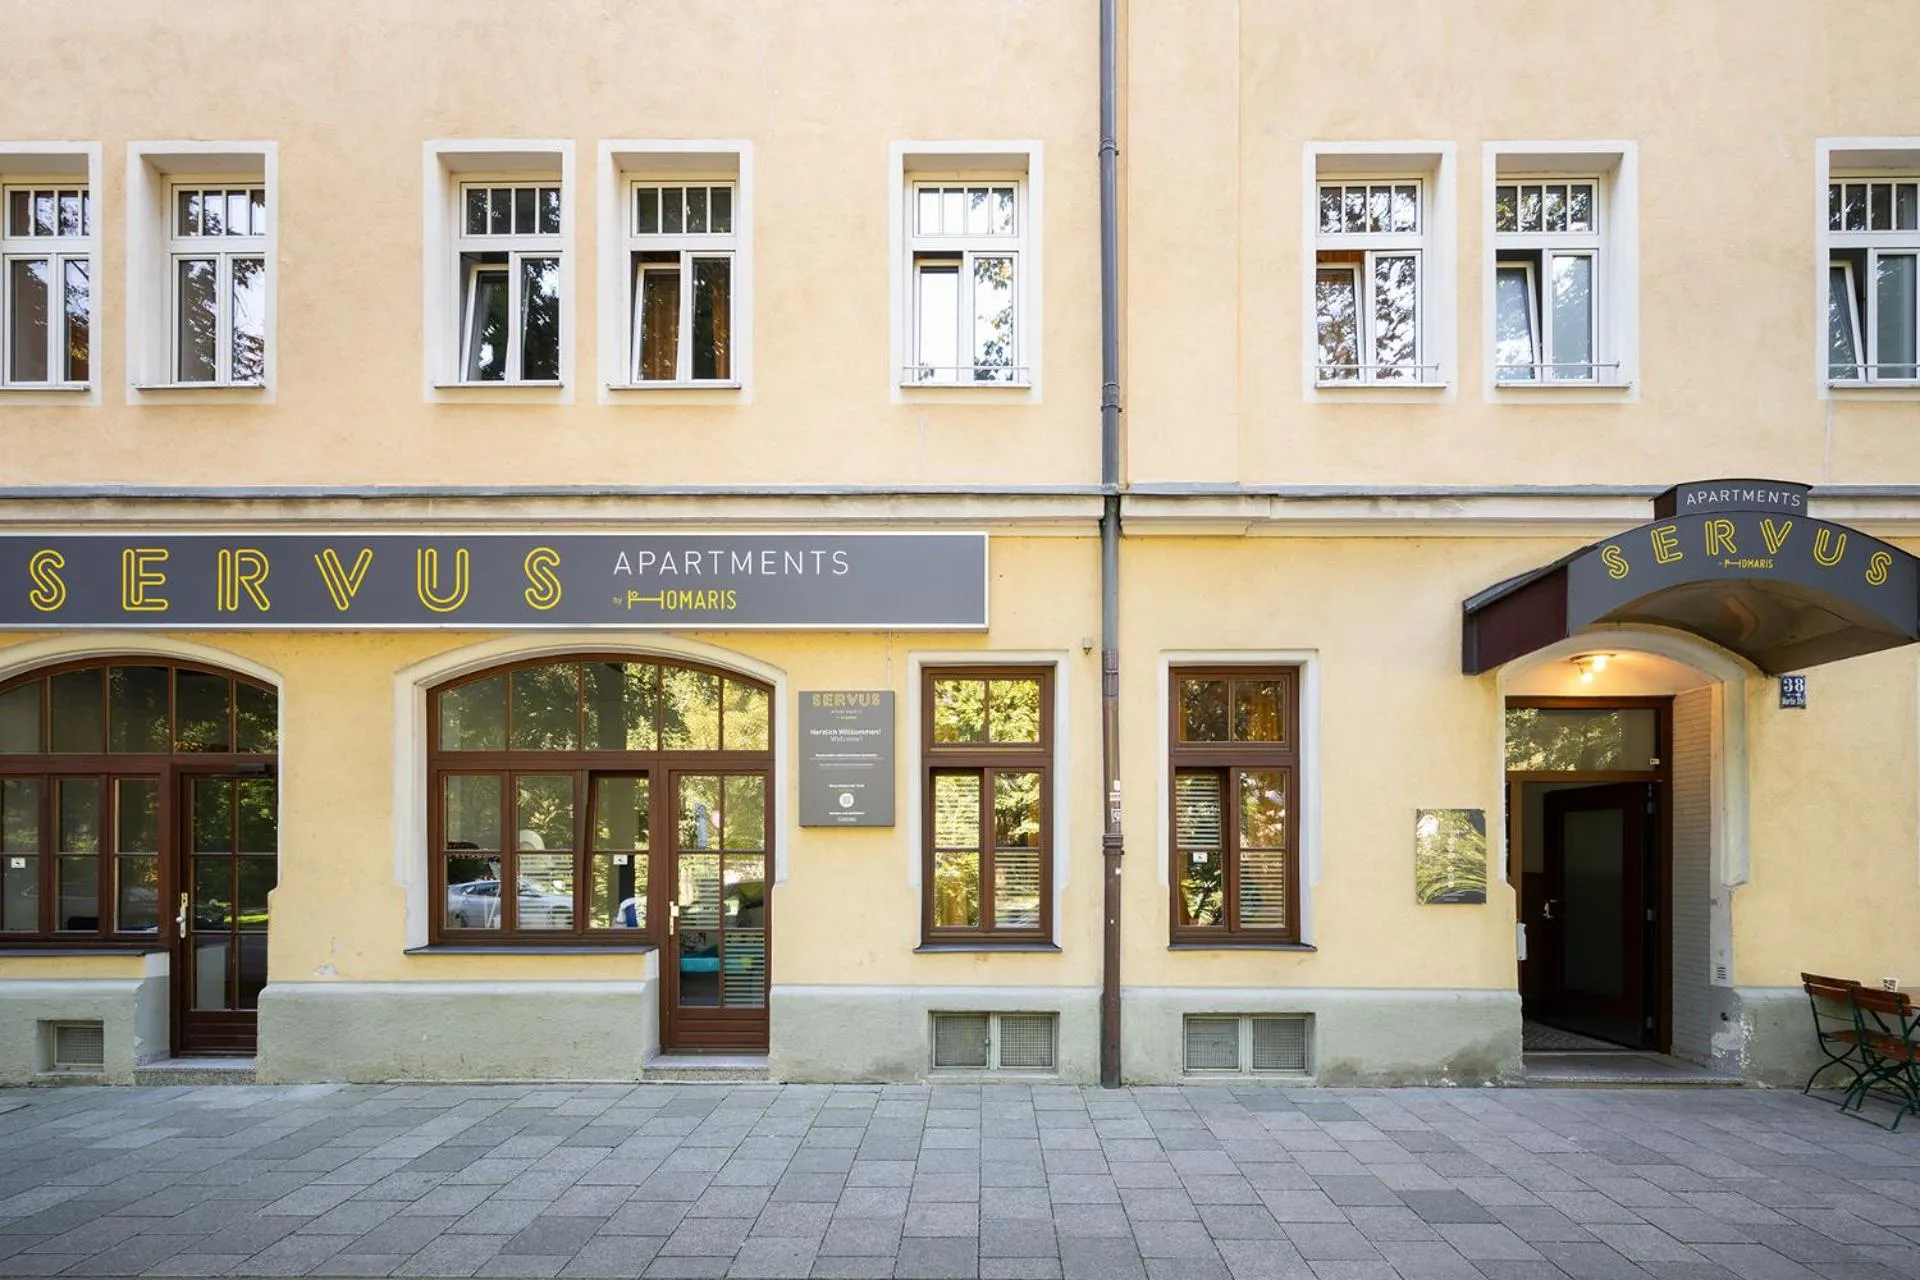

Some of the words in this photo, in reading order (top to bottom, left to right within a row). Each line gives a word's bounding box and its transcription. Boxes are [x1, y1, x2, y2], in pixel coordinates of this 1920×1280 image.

[1686, 489, 1801, 507] APARTMENTS
[613, 550, 850, 576] APARTMENTS
[1602, 518, 1892, 586] SERVUS
[29, 547, 562, 612] SERVUS
[1783, 678, 1804, 692] 38
[812, 693, 881, 707] SERVUS
